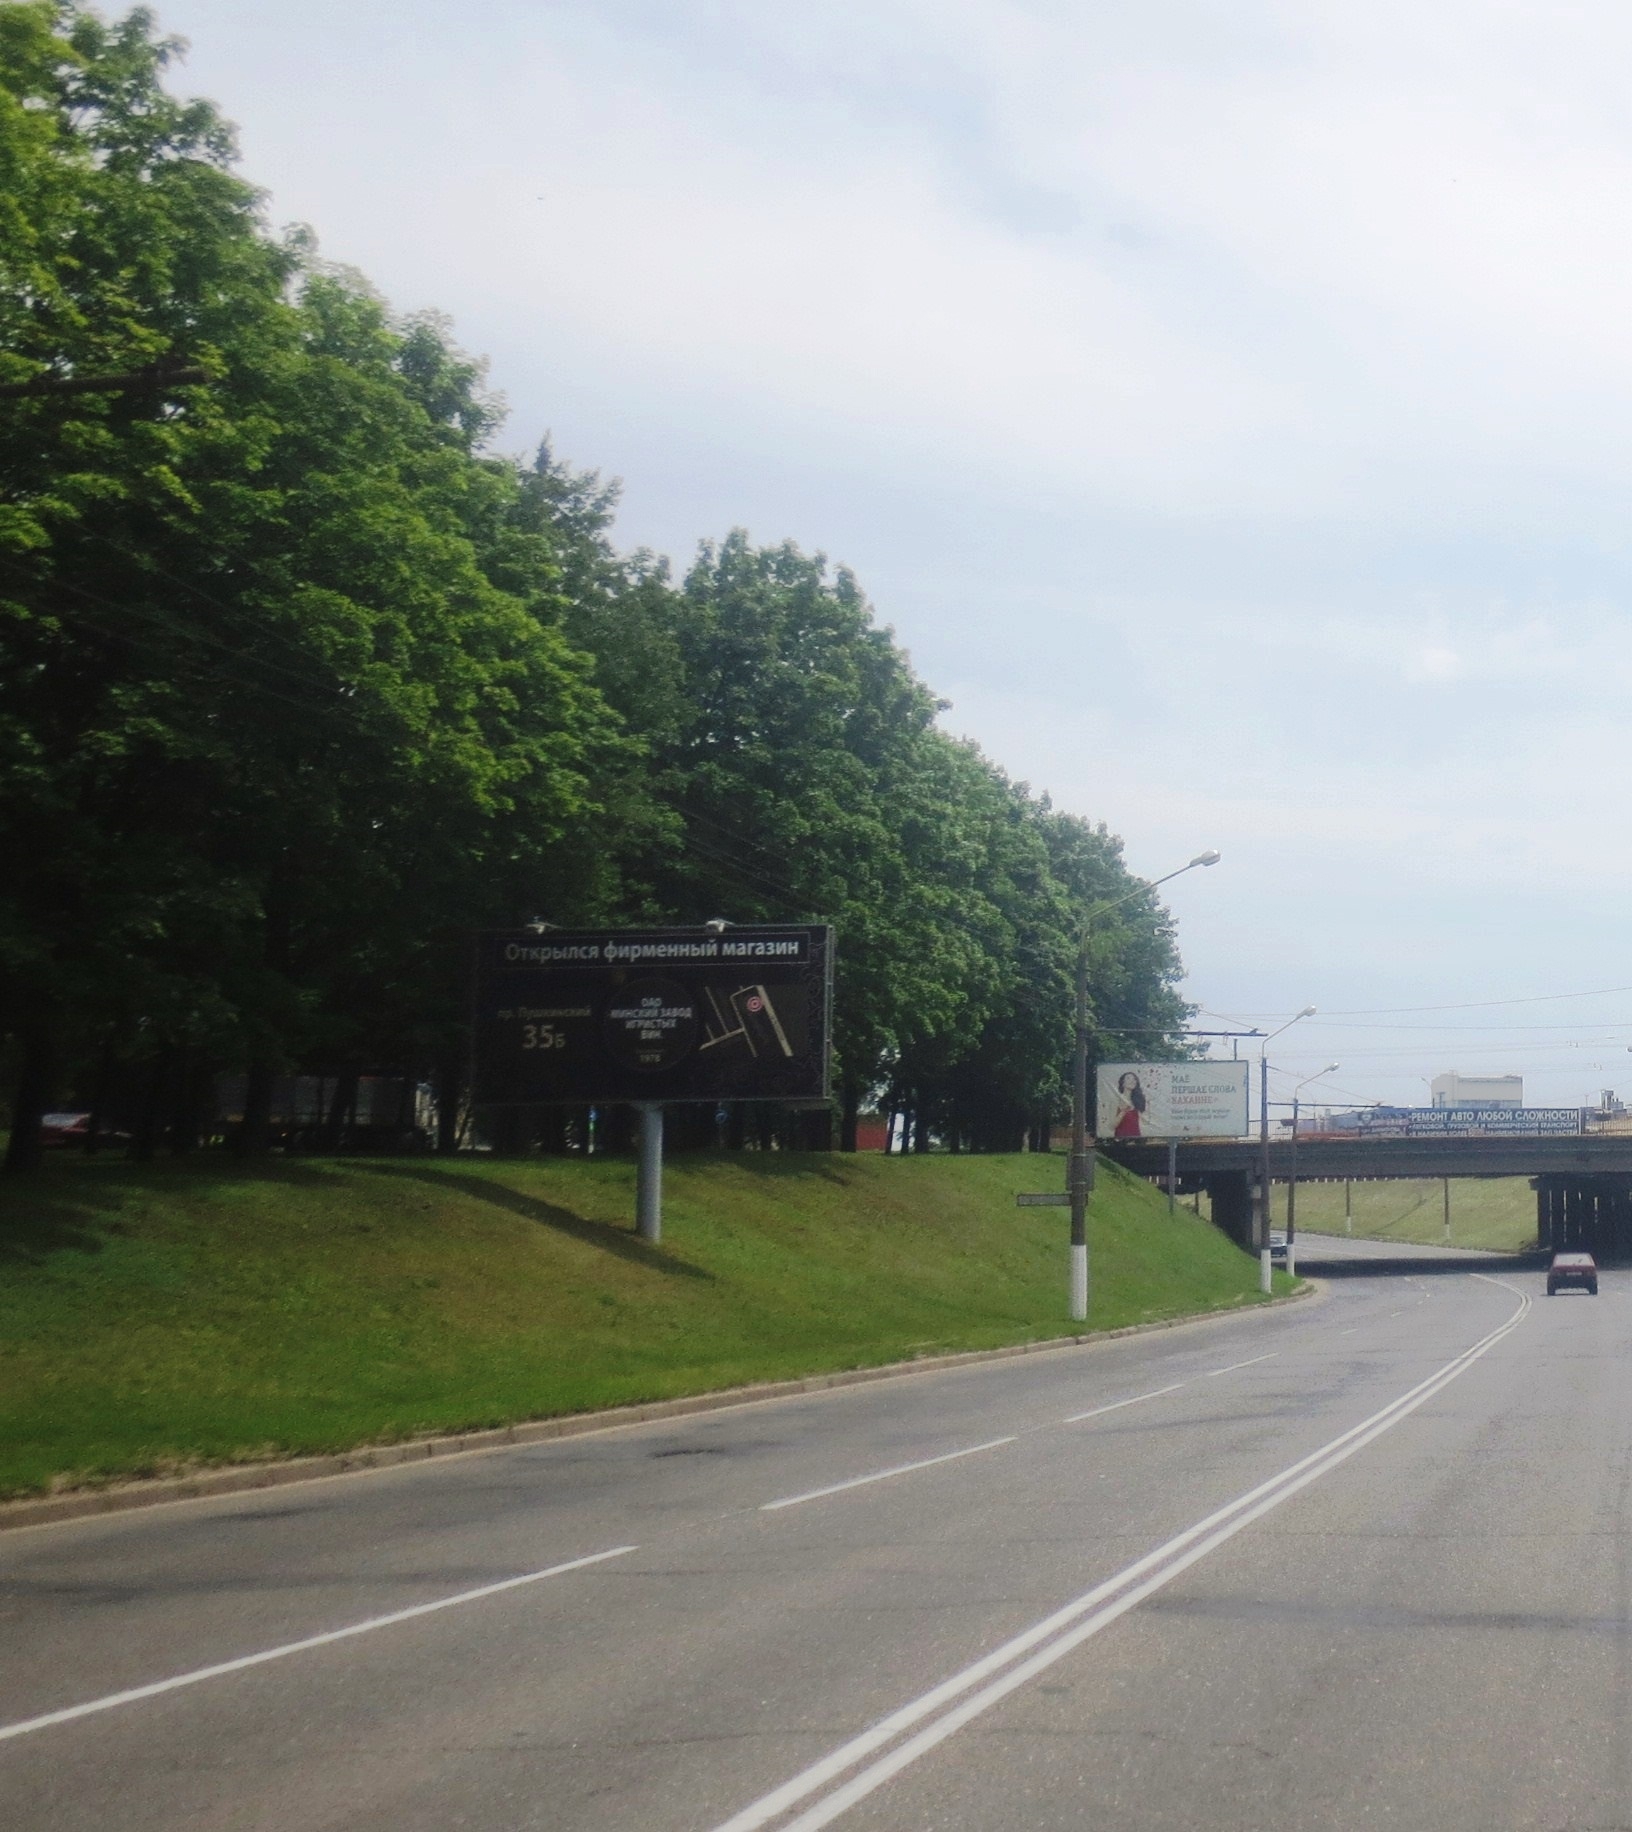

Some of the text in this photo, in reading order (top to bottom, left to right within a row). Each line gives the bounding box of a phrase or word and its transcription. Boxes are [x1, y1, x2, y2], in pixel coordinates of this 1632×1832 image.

[505, 939, 799, 963] Открылся фирменный магазин
[1451, 1111, 1474, 1121] АВТО
[1477, 1109, 1512, 1121] ЛЮБОЙ
[1515, 1110, 1578, 1121] СЛОЖНОСТИ
